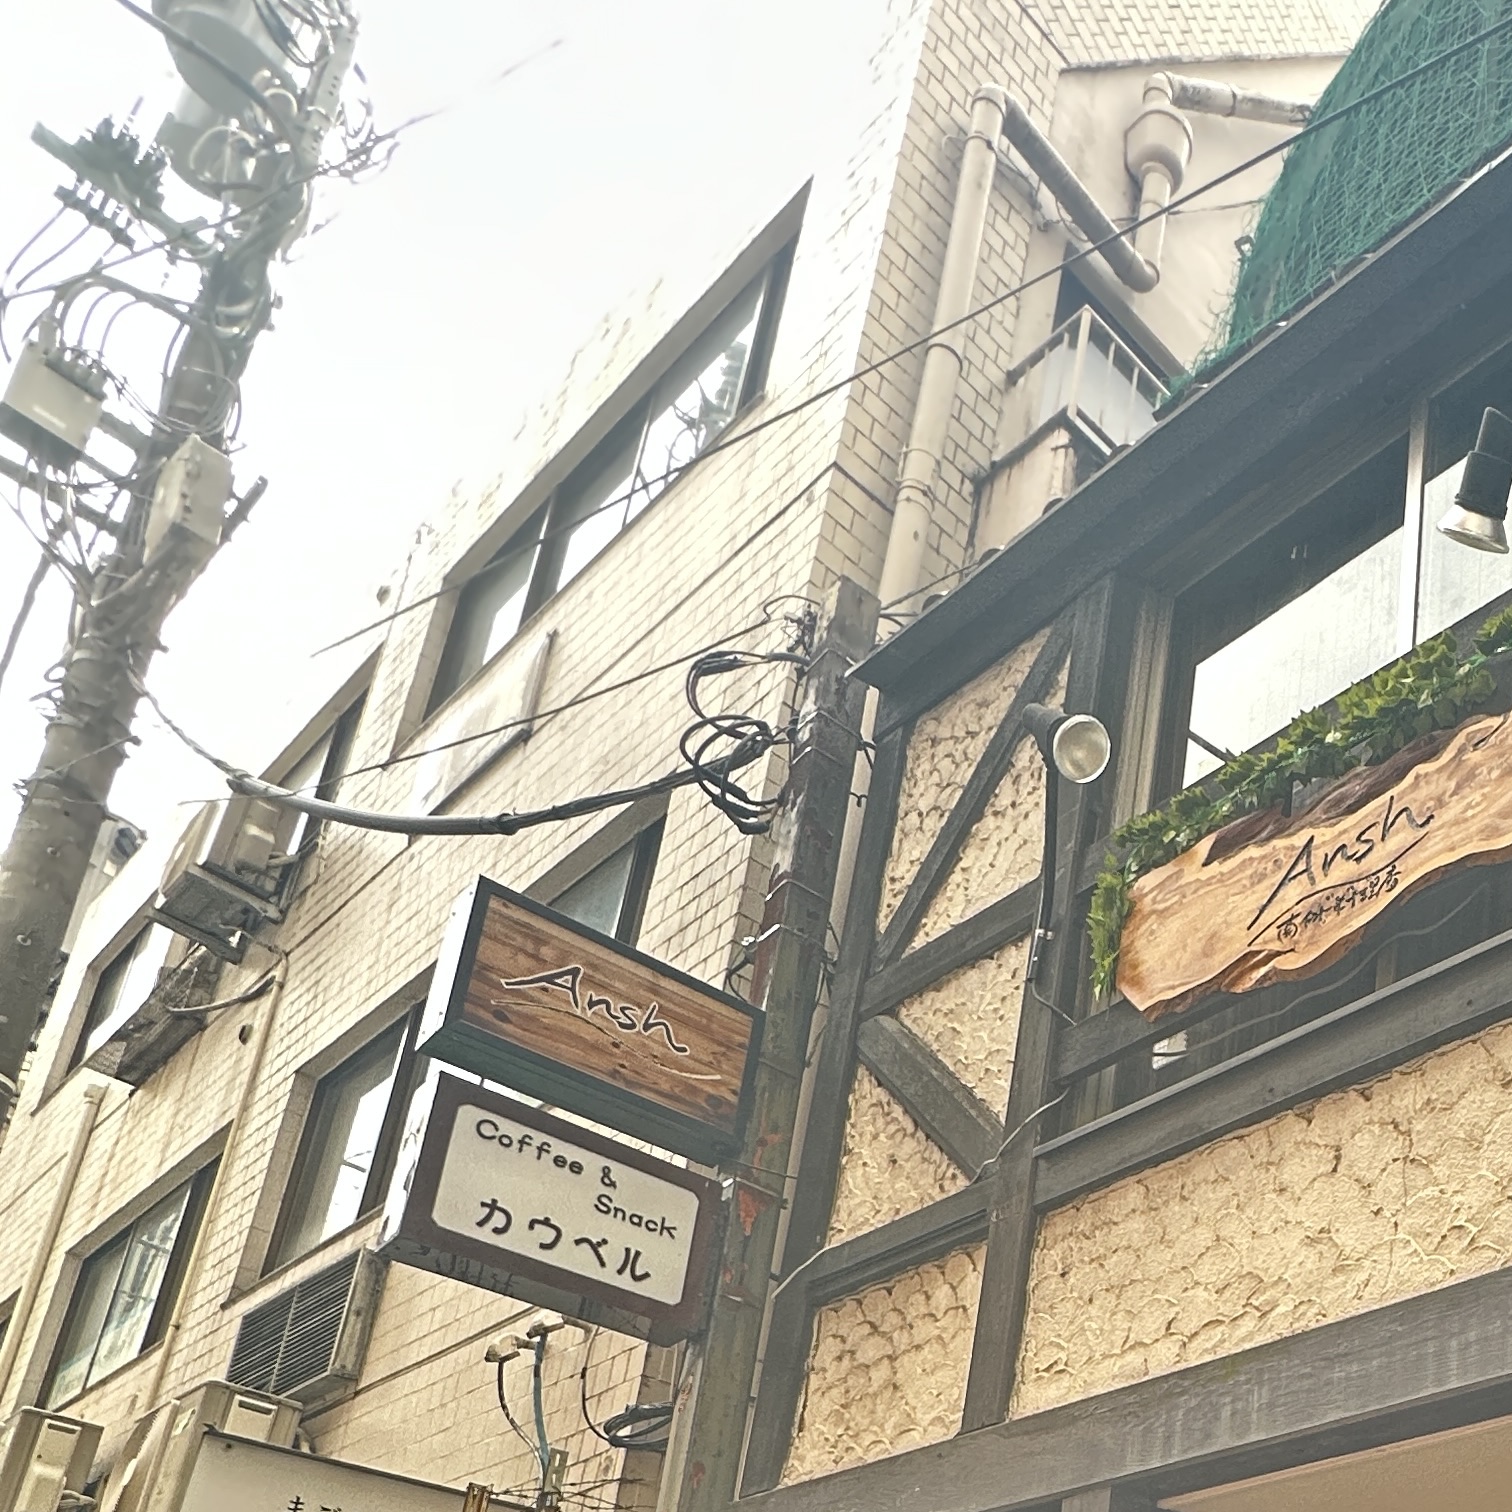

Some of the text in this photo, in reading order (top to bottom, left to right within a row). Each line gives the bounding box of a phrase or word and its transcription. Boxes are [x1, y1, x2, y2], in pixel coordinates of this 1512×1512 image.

[1247, 795, 1435, 931] Ansh
[500, 964, 690, 1056] Ansh
[475, 1118, 618, 1190] Coffee &
[474, 1198, 653, 1284] カウベル
[593, 1193, 678, 1240] Snack
